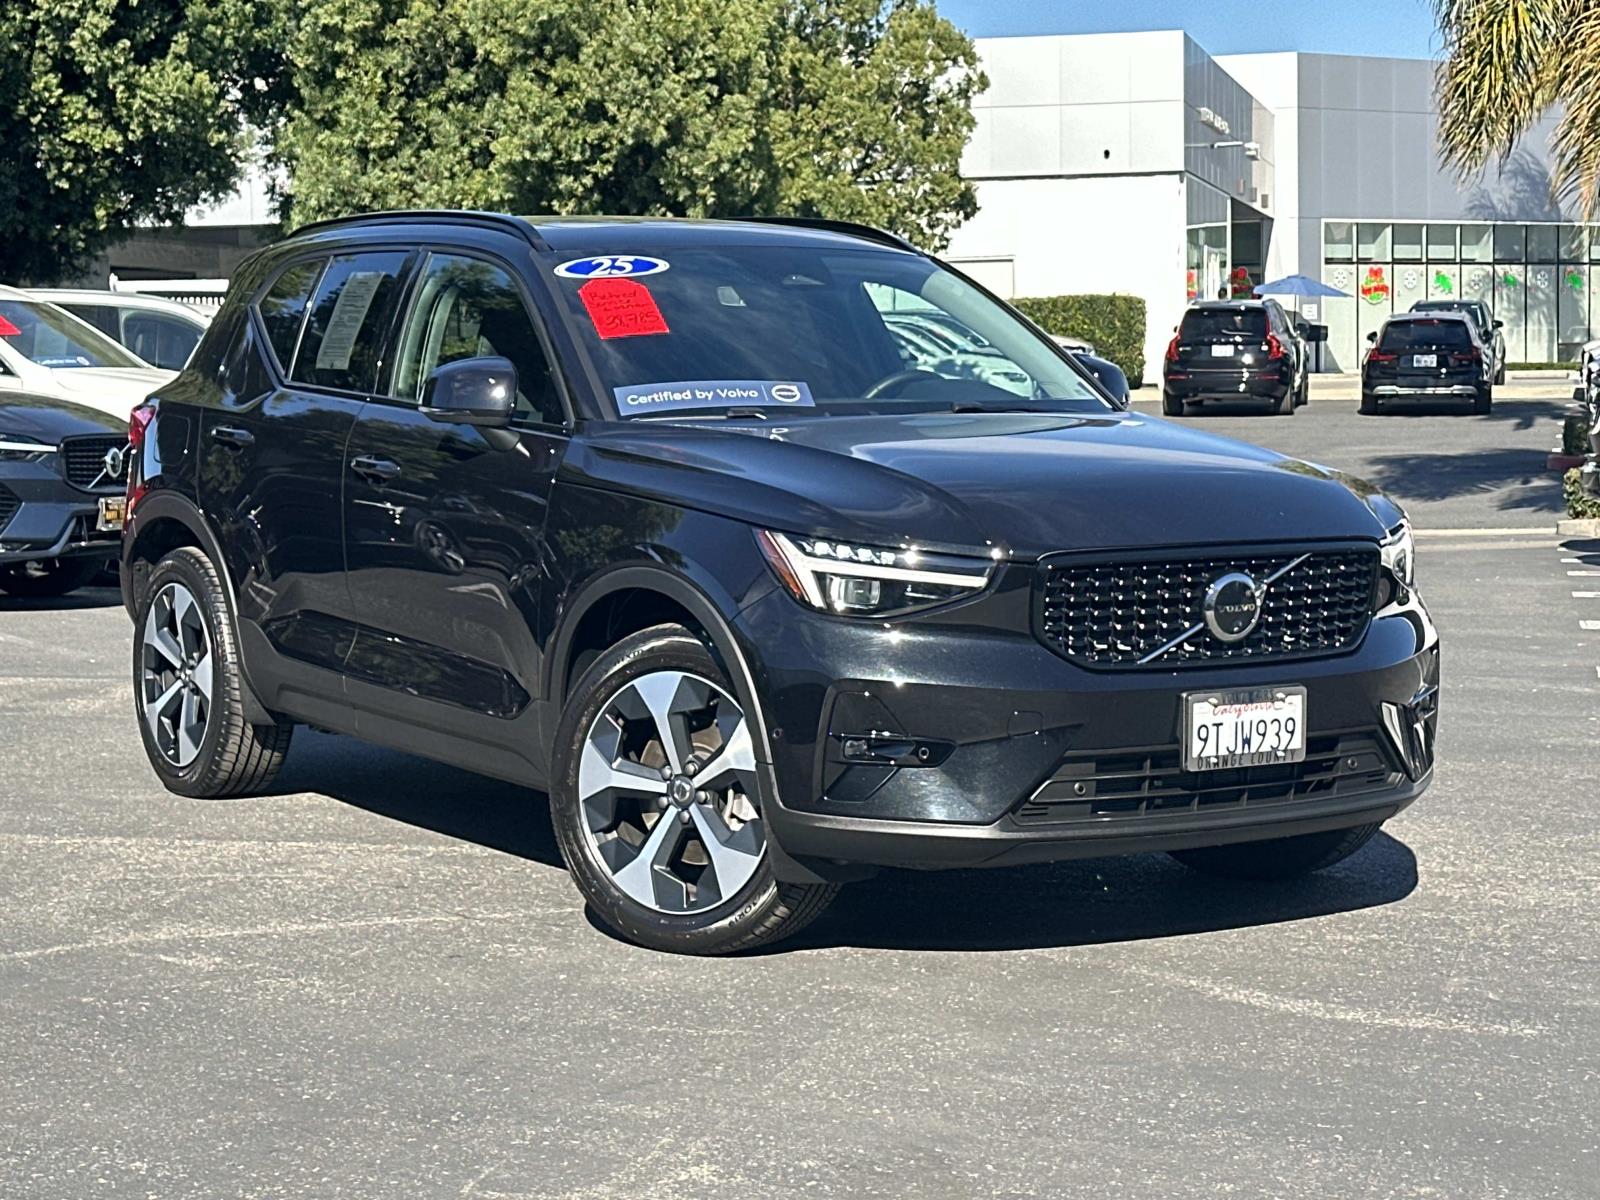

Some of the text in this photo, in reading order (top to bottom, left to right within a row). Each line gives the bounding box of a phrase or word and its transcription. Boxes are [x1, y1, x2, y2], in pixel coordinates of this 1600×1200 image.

[591, 257, 636, 275] 25
[627, 387, 759, 405] Certified by Volvo
[1217, 603, 1256, 613] VOLVO
[1197, 717, 1296, 758] 9TJW939
[1197, 749, 1297, 770] ORANGE COUNTY
